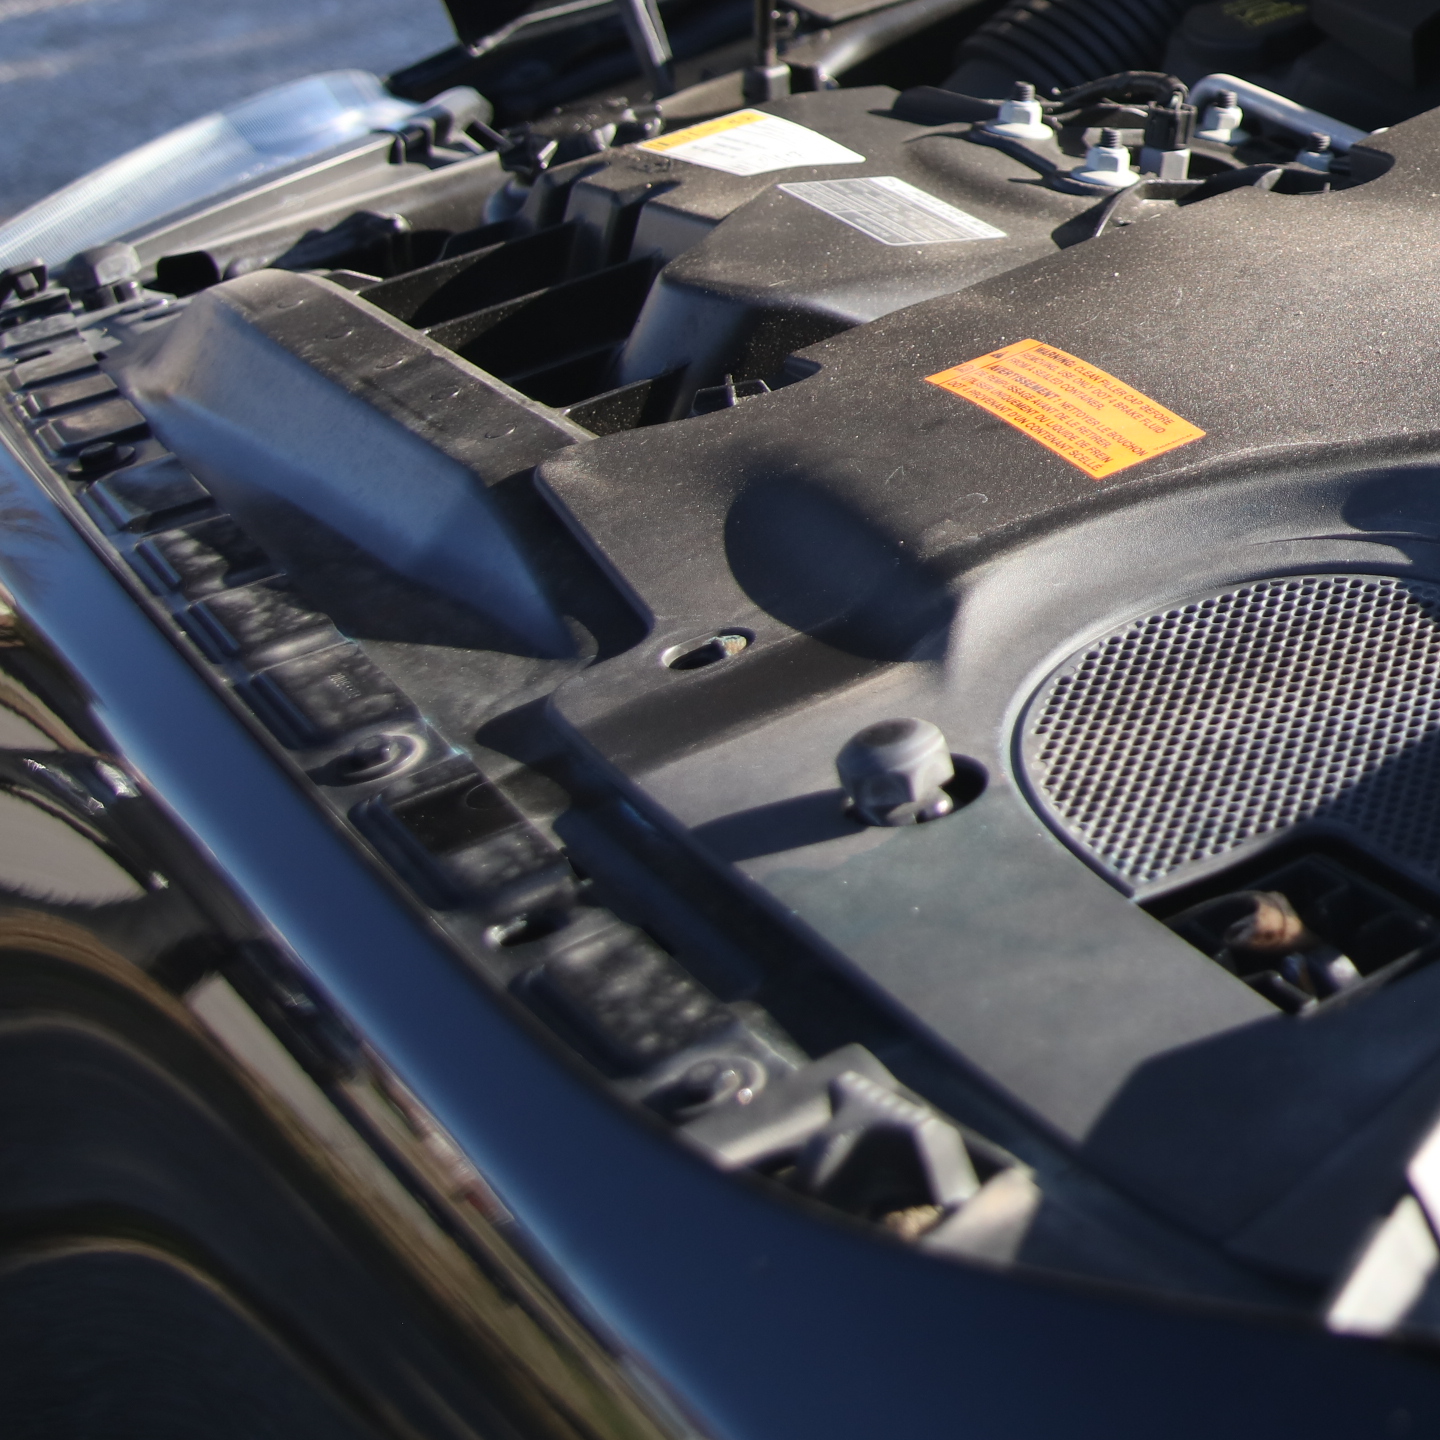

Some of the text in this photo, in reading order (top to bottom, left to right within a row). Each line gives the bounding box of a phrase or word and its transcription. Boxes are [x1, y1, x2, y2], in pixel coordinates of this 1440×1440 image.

[985, 374, 1035, 400] REMPLISSAGE
[1032, 398, 1058, 414] AVANT
[1055, 412, 1068, 421] DE
[1066, 419, 1079, 428] LE
[1033, 369, 1063, 385] SEALED
[1058, 370, 1075, 379] USE
[1073, 378, 1094, 390] ONLY
[1093, 389, 1111, 400] DOT
[1114, 402, 1143, 420] BRAKE
[1140, 418, 1165, 434] FLUID
[1074, 366, 1101, 381] CLEAN
[1099, 379, 1126, 396] FILLER
[1124, 394, 1143, 406] CAP
[1140, 404, 1174, 425] BEFORE
[948, 381, 966, 390] DOT
[967, 389, 1011, 413] PROVENANT
[1008, 411, 1028, 424] D'UN
[1025, 422, 1072, 452] CONTENANT
[990, 389, 1039, 416] UNIQUEMENT
[1035, 414, 1050, 423] DU
[1047, 421, 1078, 441] LIQUIDE
[1075, 439, 1090, 448] DE
[1087, 446, 1112, 463] FREIN
[1060, 401, 1100, 426] NETTOYER
[1097, 424, 1110, 433] LE
[1107, 431, 1147, 456] BOUCHON
